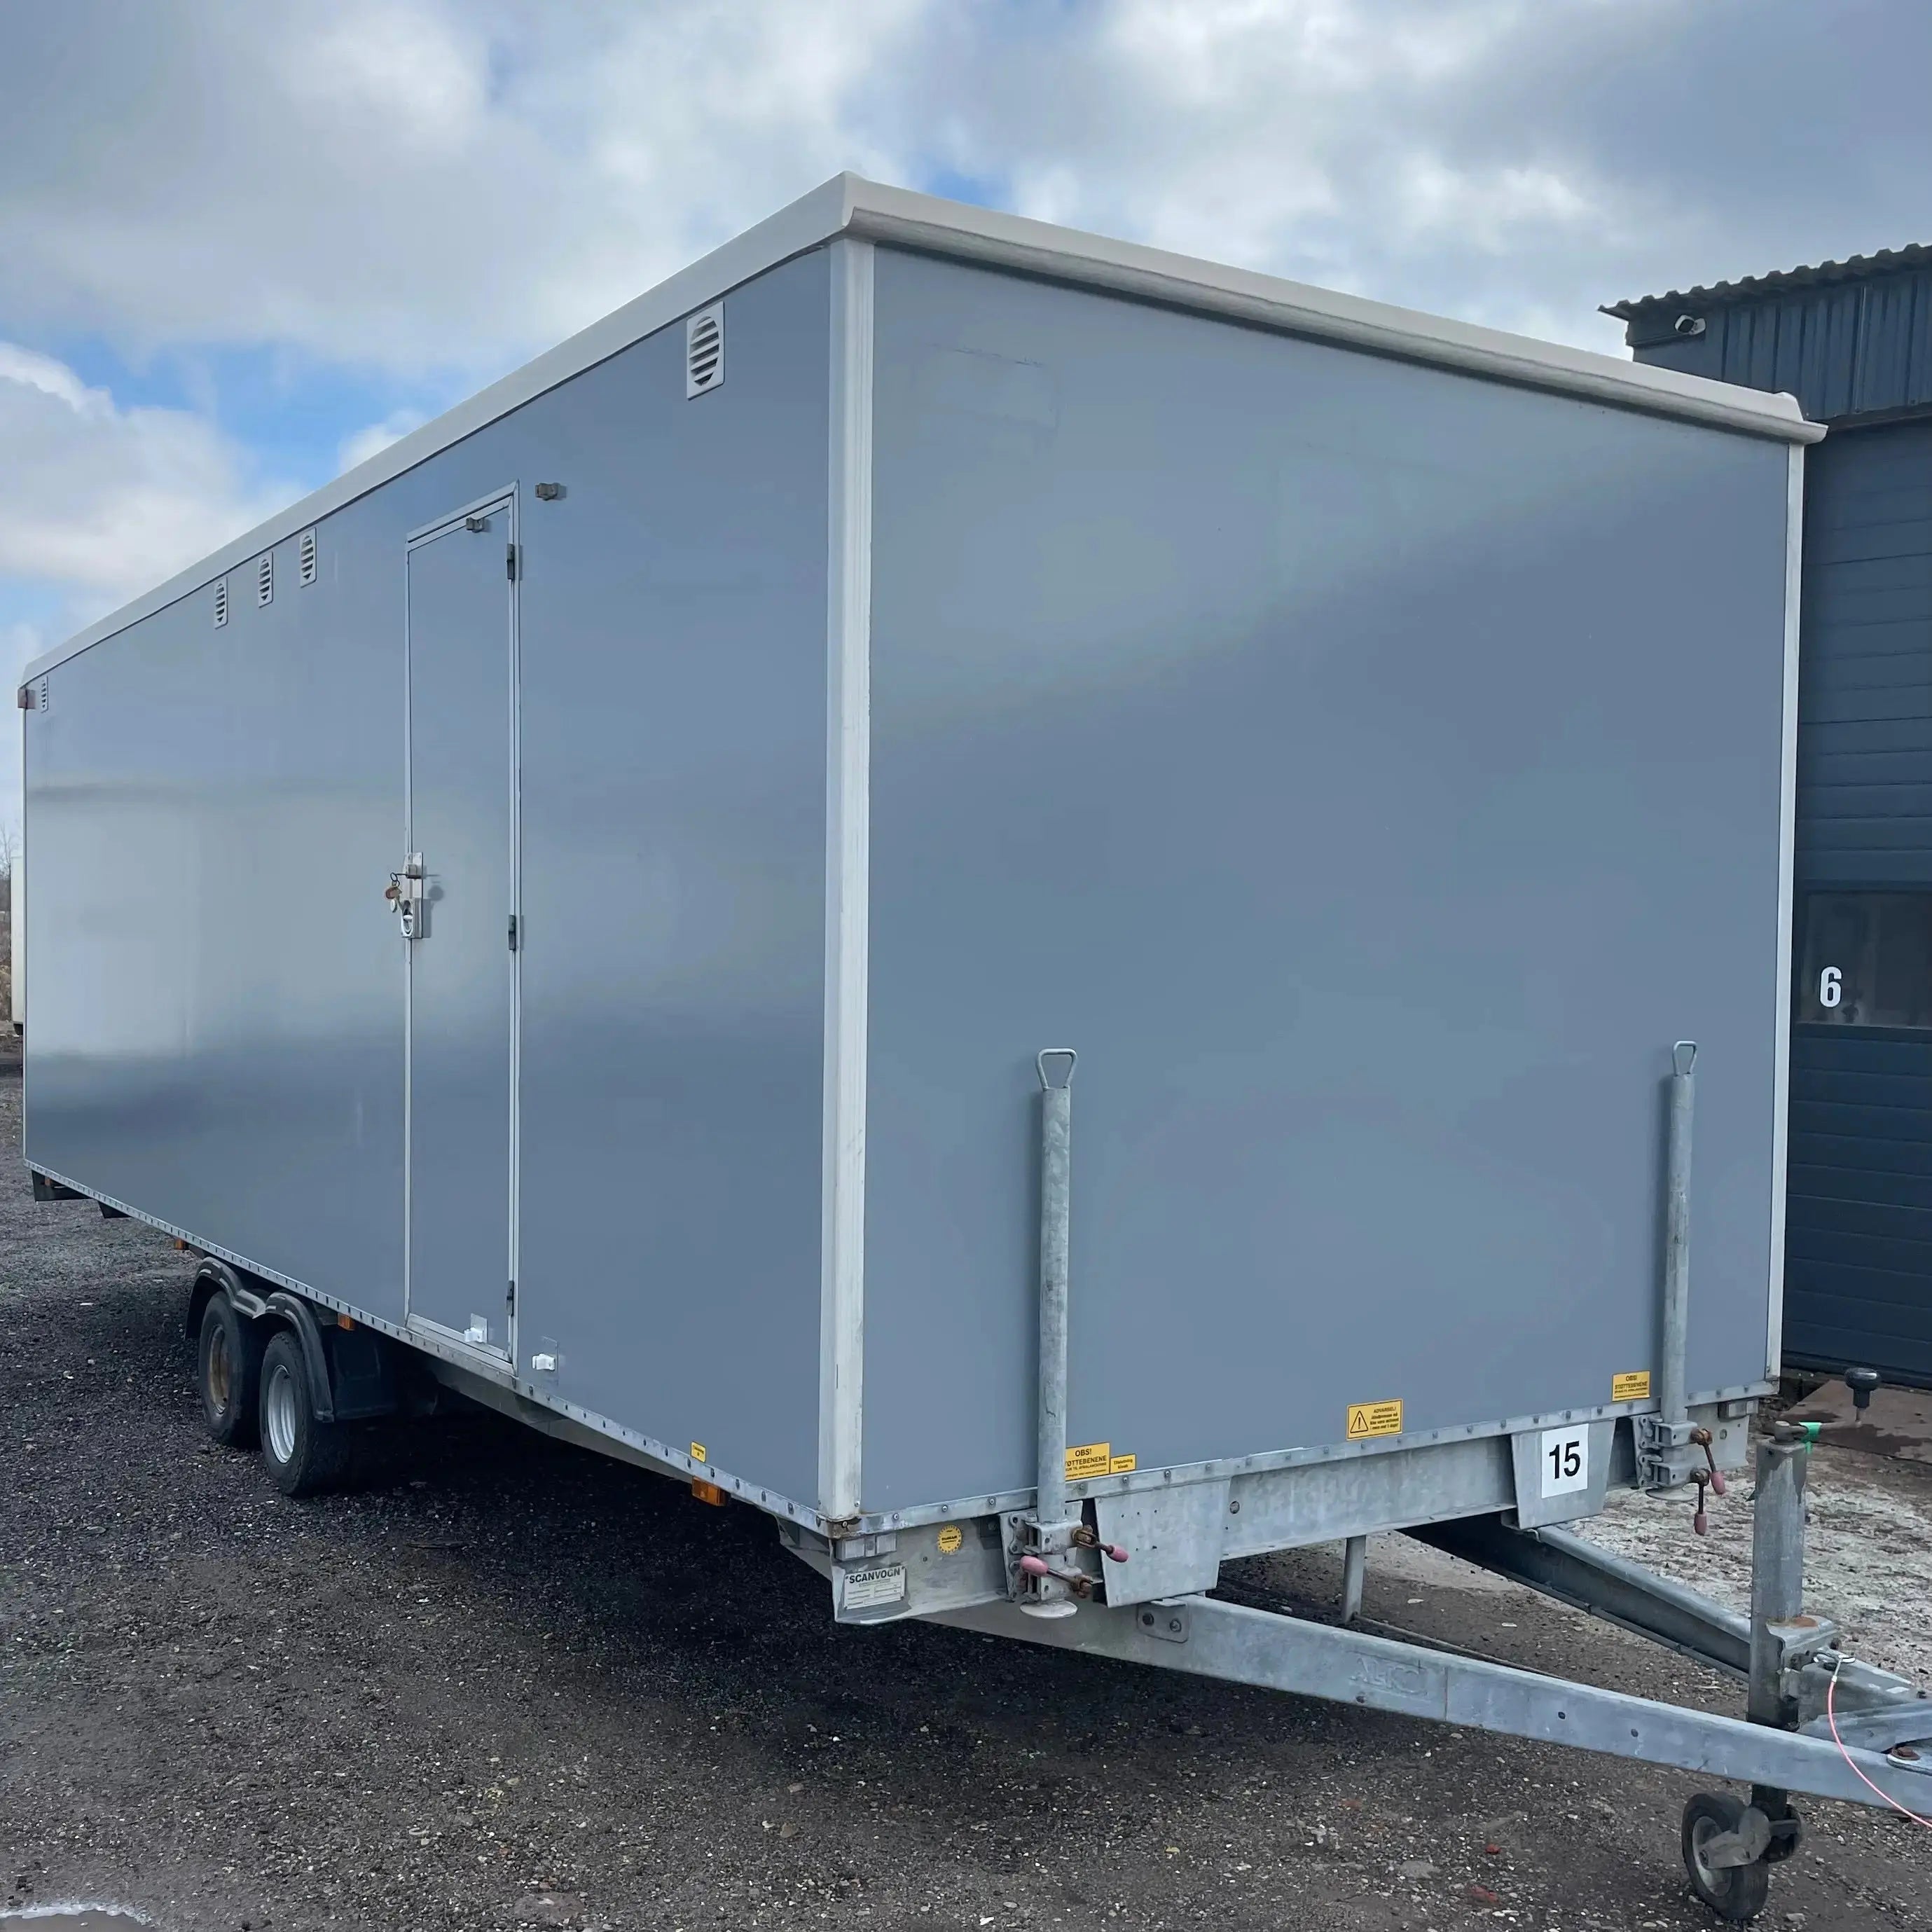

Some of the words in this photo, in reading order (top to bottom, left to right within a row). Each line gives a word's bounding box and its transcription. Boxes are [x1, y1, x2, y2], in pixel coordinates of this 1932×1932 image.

[1820, 966, 1842, 1008] 6
[1065, 1455, 1107, 1467] ØTTEBENENE
[1075, 1448, 1092, 1457] OBS!
[1549, 1440, 1581, 1479] 15
[849, 1567, 900, 1584] SCANVOGN
